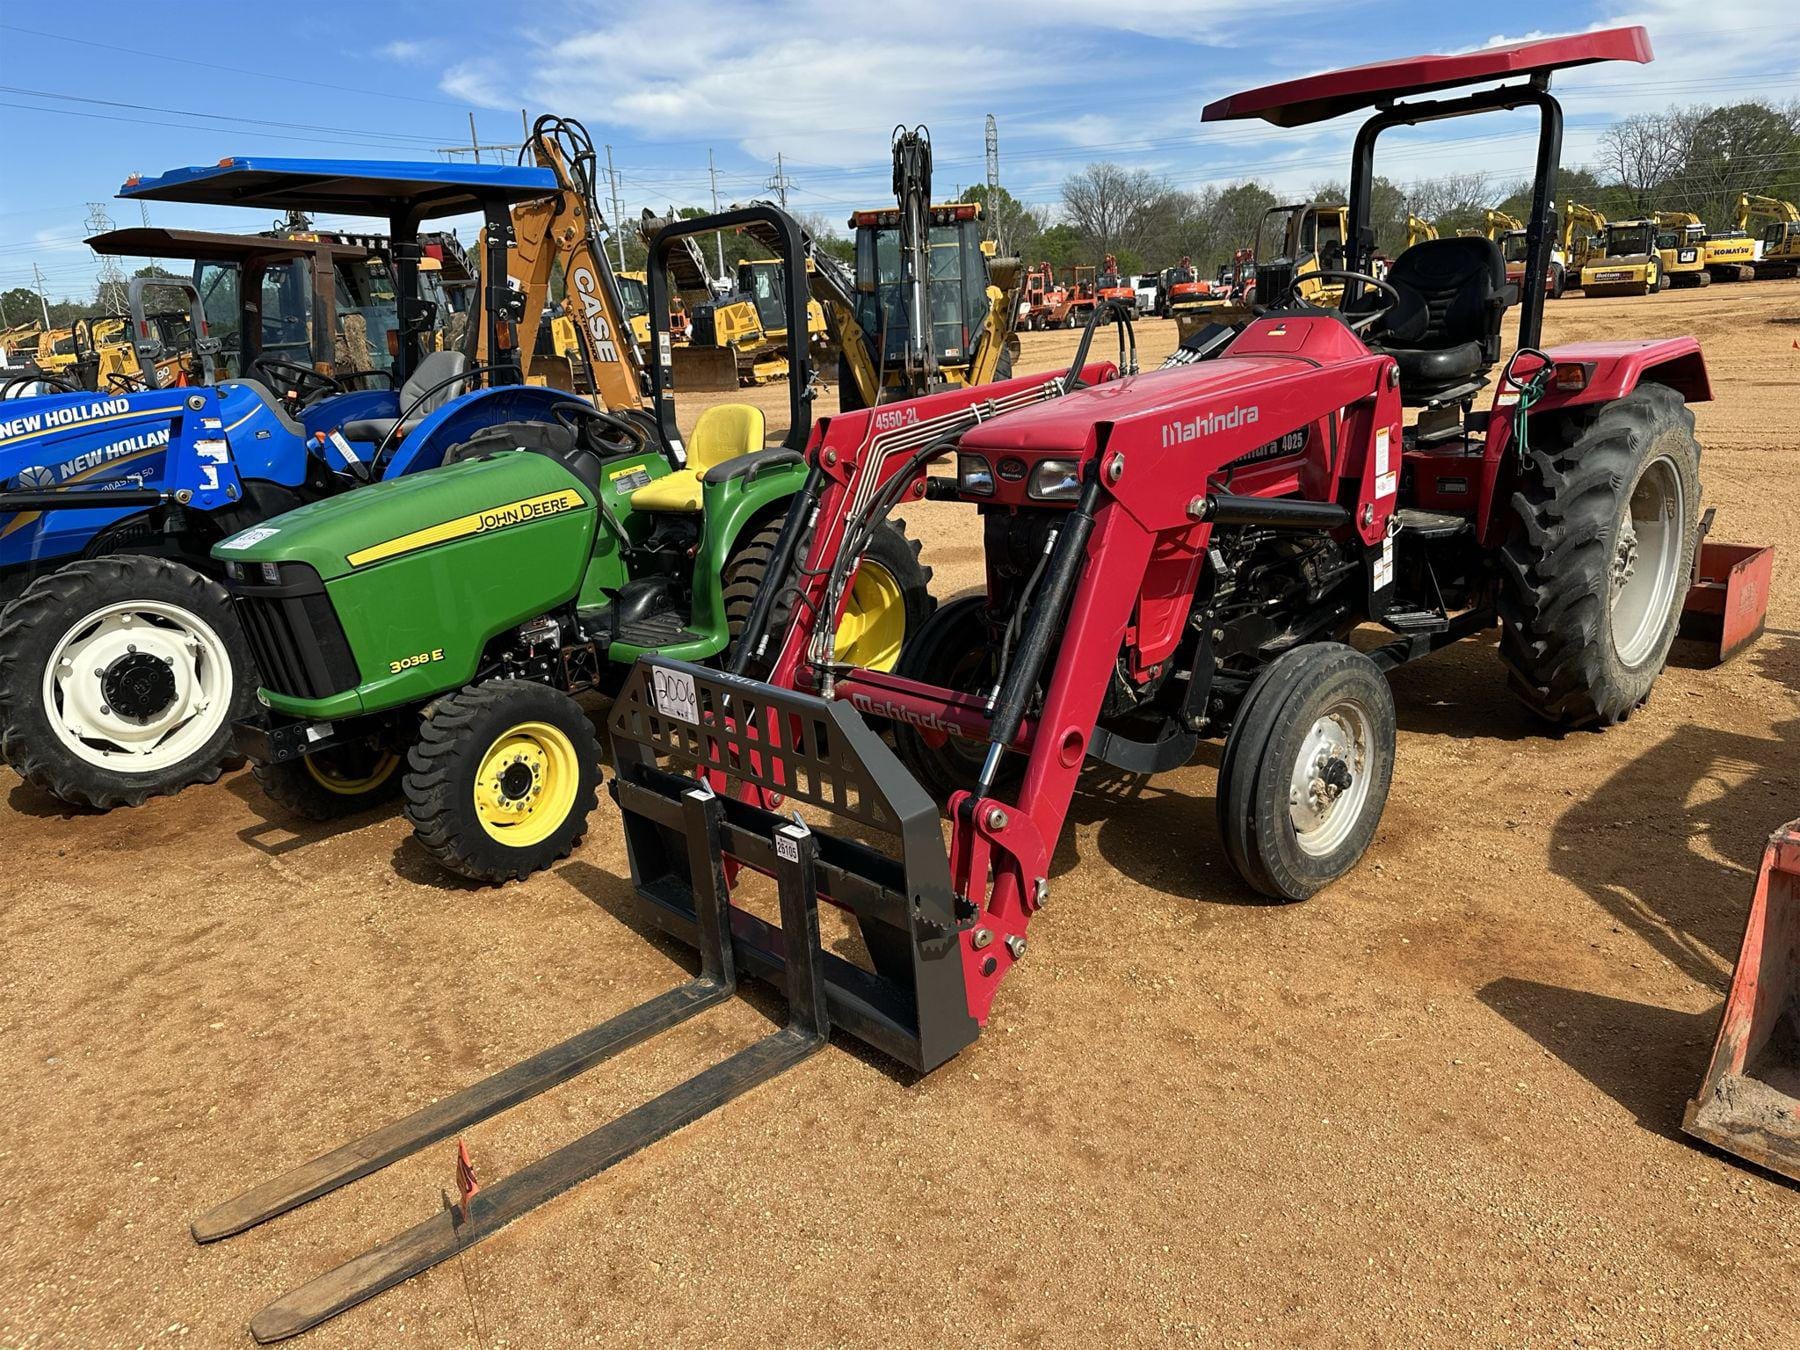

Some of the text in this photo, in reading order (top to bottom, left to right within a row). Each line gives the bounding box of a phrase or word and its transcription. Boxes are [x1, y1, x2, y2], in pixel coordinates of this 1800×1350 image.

[1680, 251, 1696, 262] CAT
[1713, 246, 1750, 256] KOMATSU
[573, 267, 619, 362] CASE
[156, 366, 170, 381] 90
[0, 398, 130, 439] NEW HOLLAND
[875, 407, 920, 430] 4550-2L
[1162, 405, 1259, 448] Mahindra
[60, 452, 103, 480] NEW
[106, 428, 170, 460] HOLLAN
[1282, 433, 1303, 451] 4025
[142, 467, 154, 478] 50
[476, 497, 570, 531] JOHN DEERE
[389, 648, 444, 674] 3038 E
[655, 671, 696, 705] 2006
[852, 692, 963, 737] Mahindra
[777, 841, 798, 859] 26105
